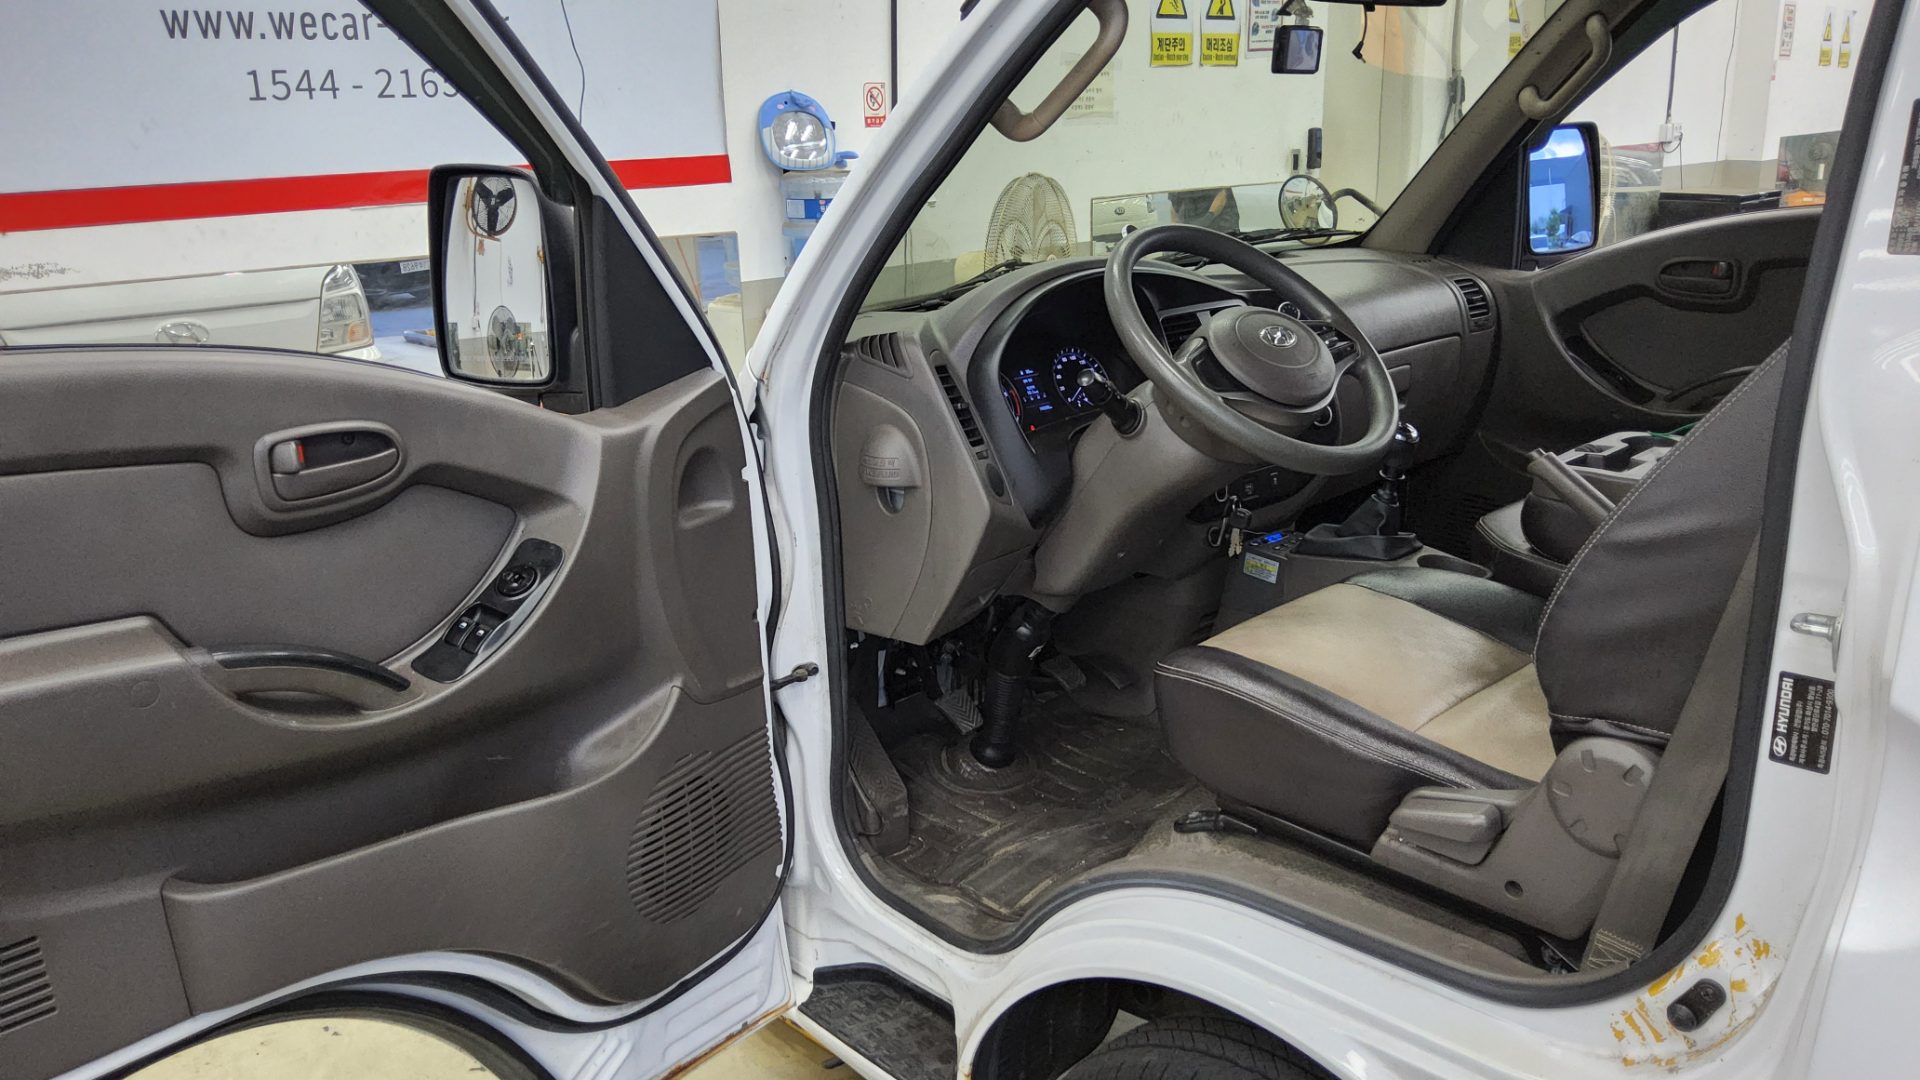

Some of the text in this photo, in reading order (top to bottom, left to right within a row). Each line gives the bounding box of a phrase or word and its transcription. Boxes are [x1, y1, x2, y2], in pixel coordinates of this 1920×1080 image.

[159, 10, 388, 41] www.wecar-
[1157, 38, 1185, 51] 계단주의
[1207, 38, 1233, 52] 머리조심
[247, 69, 340, 100] 1544
[1777, 678, 1794, 733] HYUNDAI
